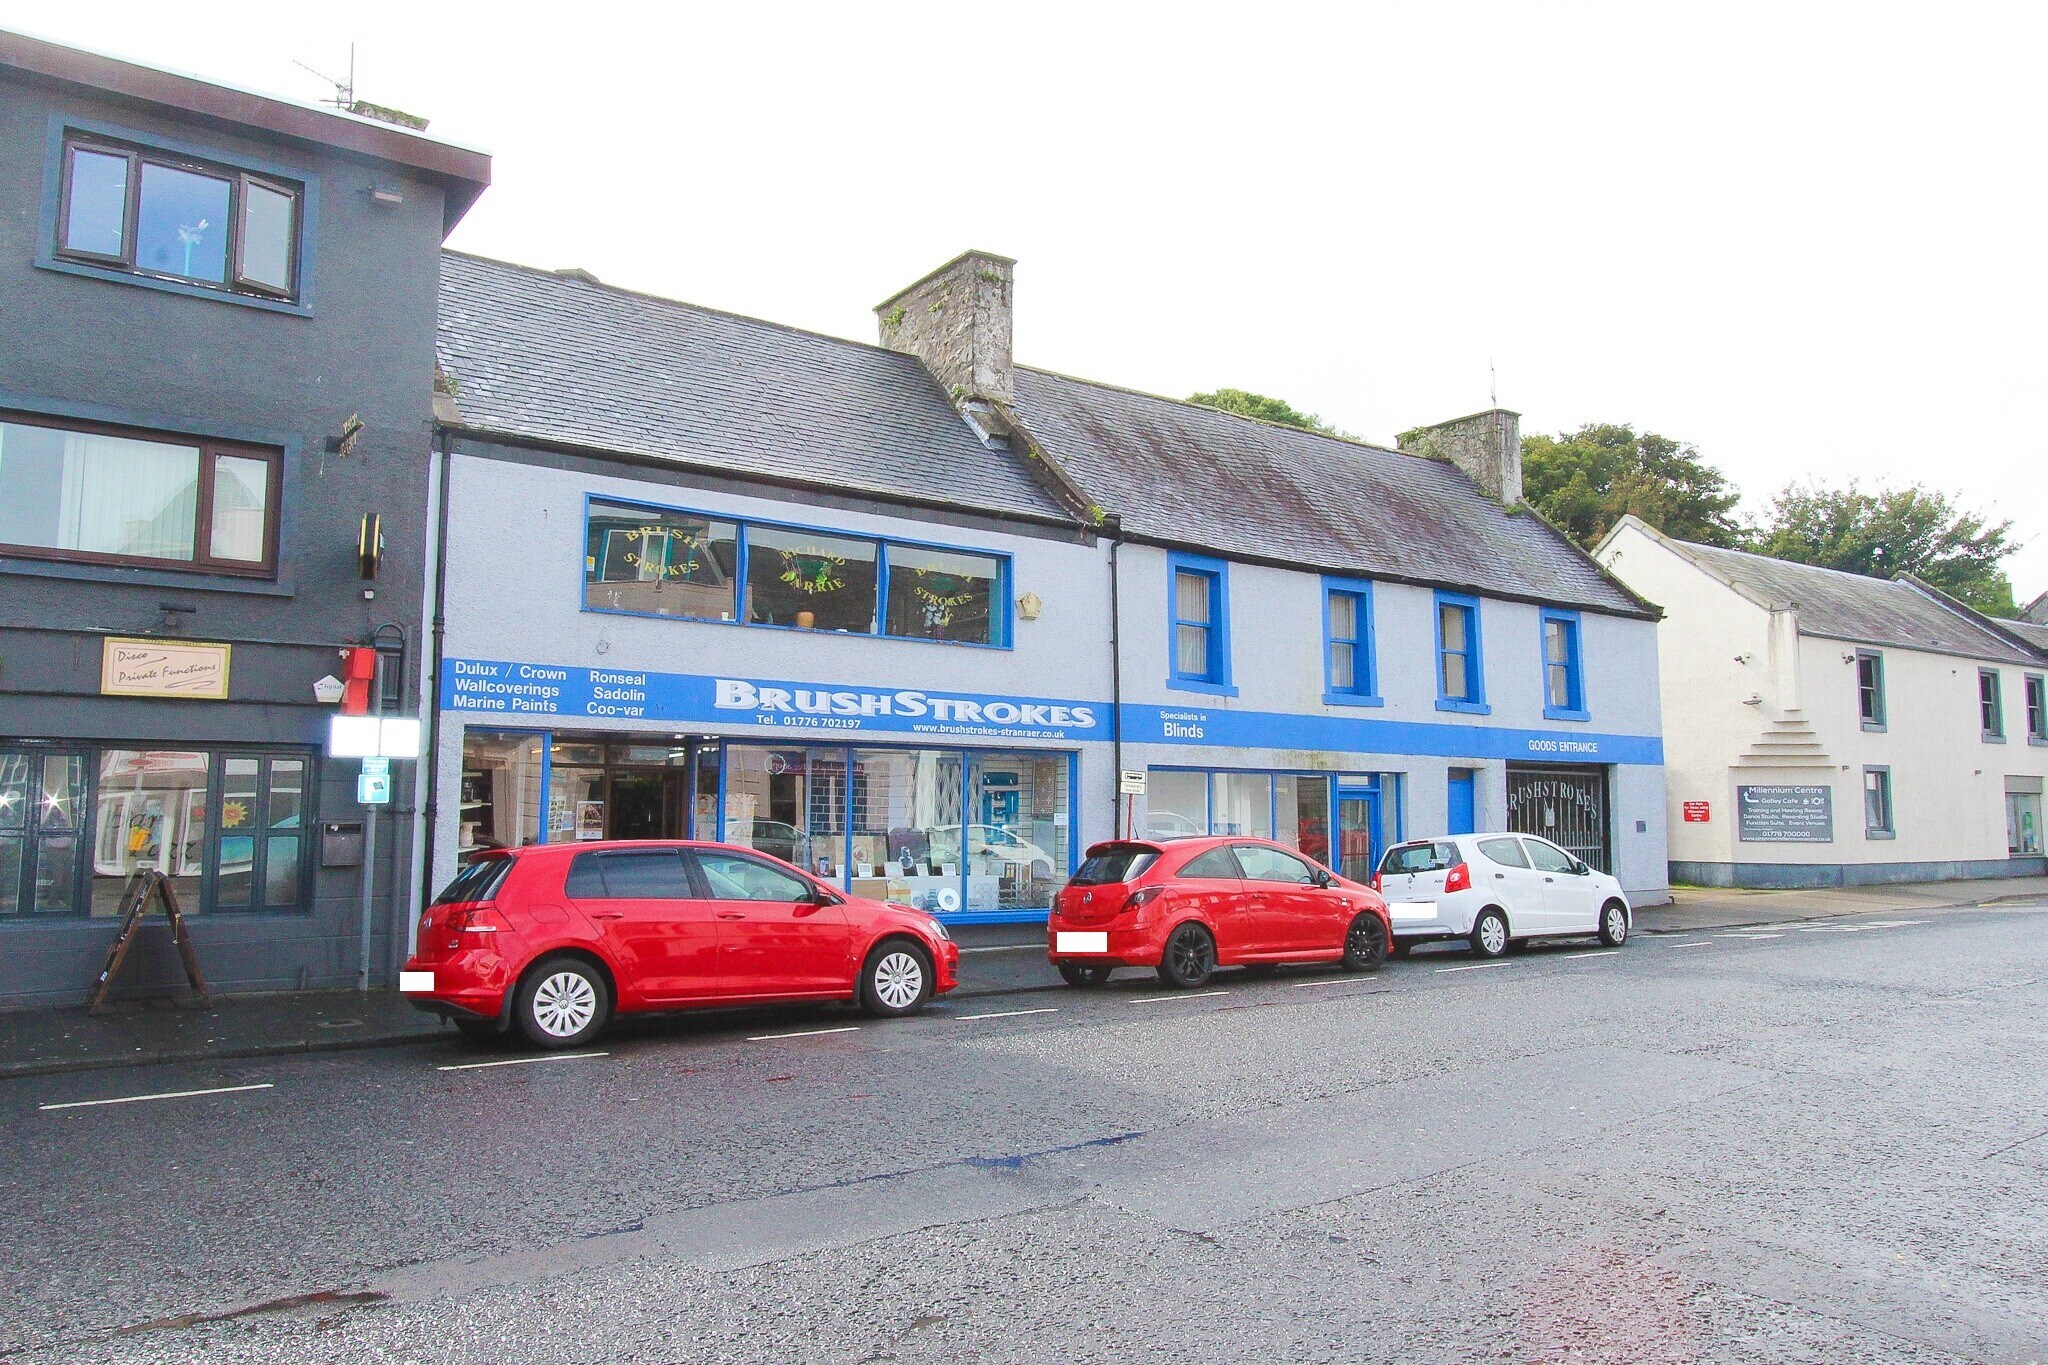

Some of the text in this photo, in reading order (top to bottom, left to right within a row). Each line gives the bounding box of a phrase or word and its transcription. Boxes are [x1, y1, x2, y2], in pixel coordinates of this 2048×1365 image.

[623, 552, 700, 576] STROKES
[914, 586, 973, 607] STROKES
[118, 651, 148, 661] Disco
[119, 664, 216, 682] Private Functions
[455, 661, 498, 677] Dulux
[519, 665, 567, 681] Crown
[590, 670, 646, 686] Ronseal
[455, 678, 560, 698] Wallcoverings
[593, 686, 646, 702] Sadolin
[453, 695, 558, 712] Marine Paints
[586, 701, 645, 717] Coo-var
[757, 714, 861, 729] Tel. 01776 702197
[1160, 711, 1207, 721] Specialists in
[913, 724, 1065, 739] www.brushstrokes-stranraer.co.uk
[1163, 722, 1204, 738] Blinds
[1528, 740, 1598, 753] GOODS ENTRANCE
[1509, 781, 1597, 819] RUSHSTROKES
